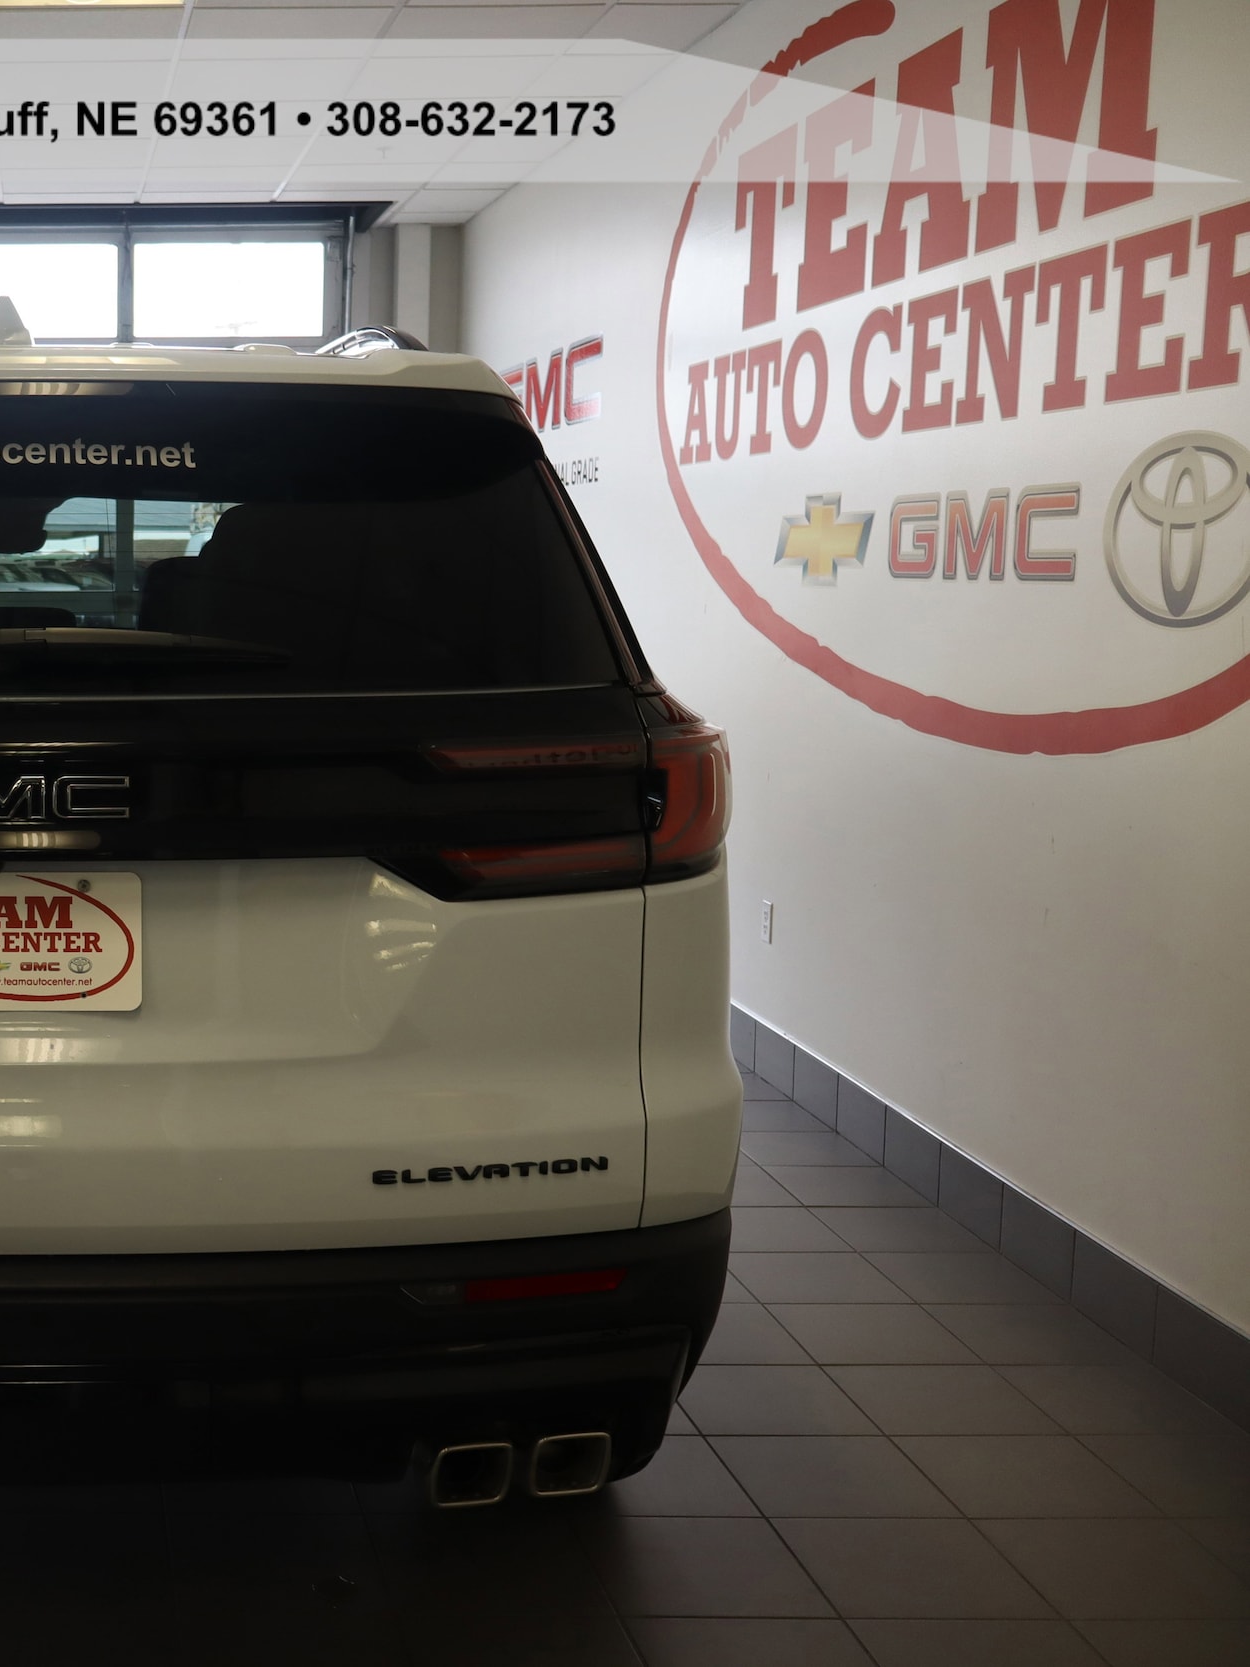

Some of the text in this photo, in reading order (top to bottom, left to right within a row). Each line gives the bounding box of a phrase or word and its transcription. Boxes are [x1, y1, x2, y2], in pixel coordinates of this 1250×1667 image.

[735, 0, 1157, 331] TEAM
[679, 328, 829, 466] AUTO
[571, 456, 599, 485] GRADE
[887, 481, 1084, 582] GMC
[19, 962, 62, 972] GMC
[371, 1156, 609, 1185] ELEVATION
